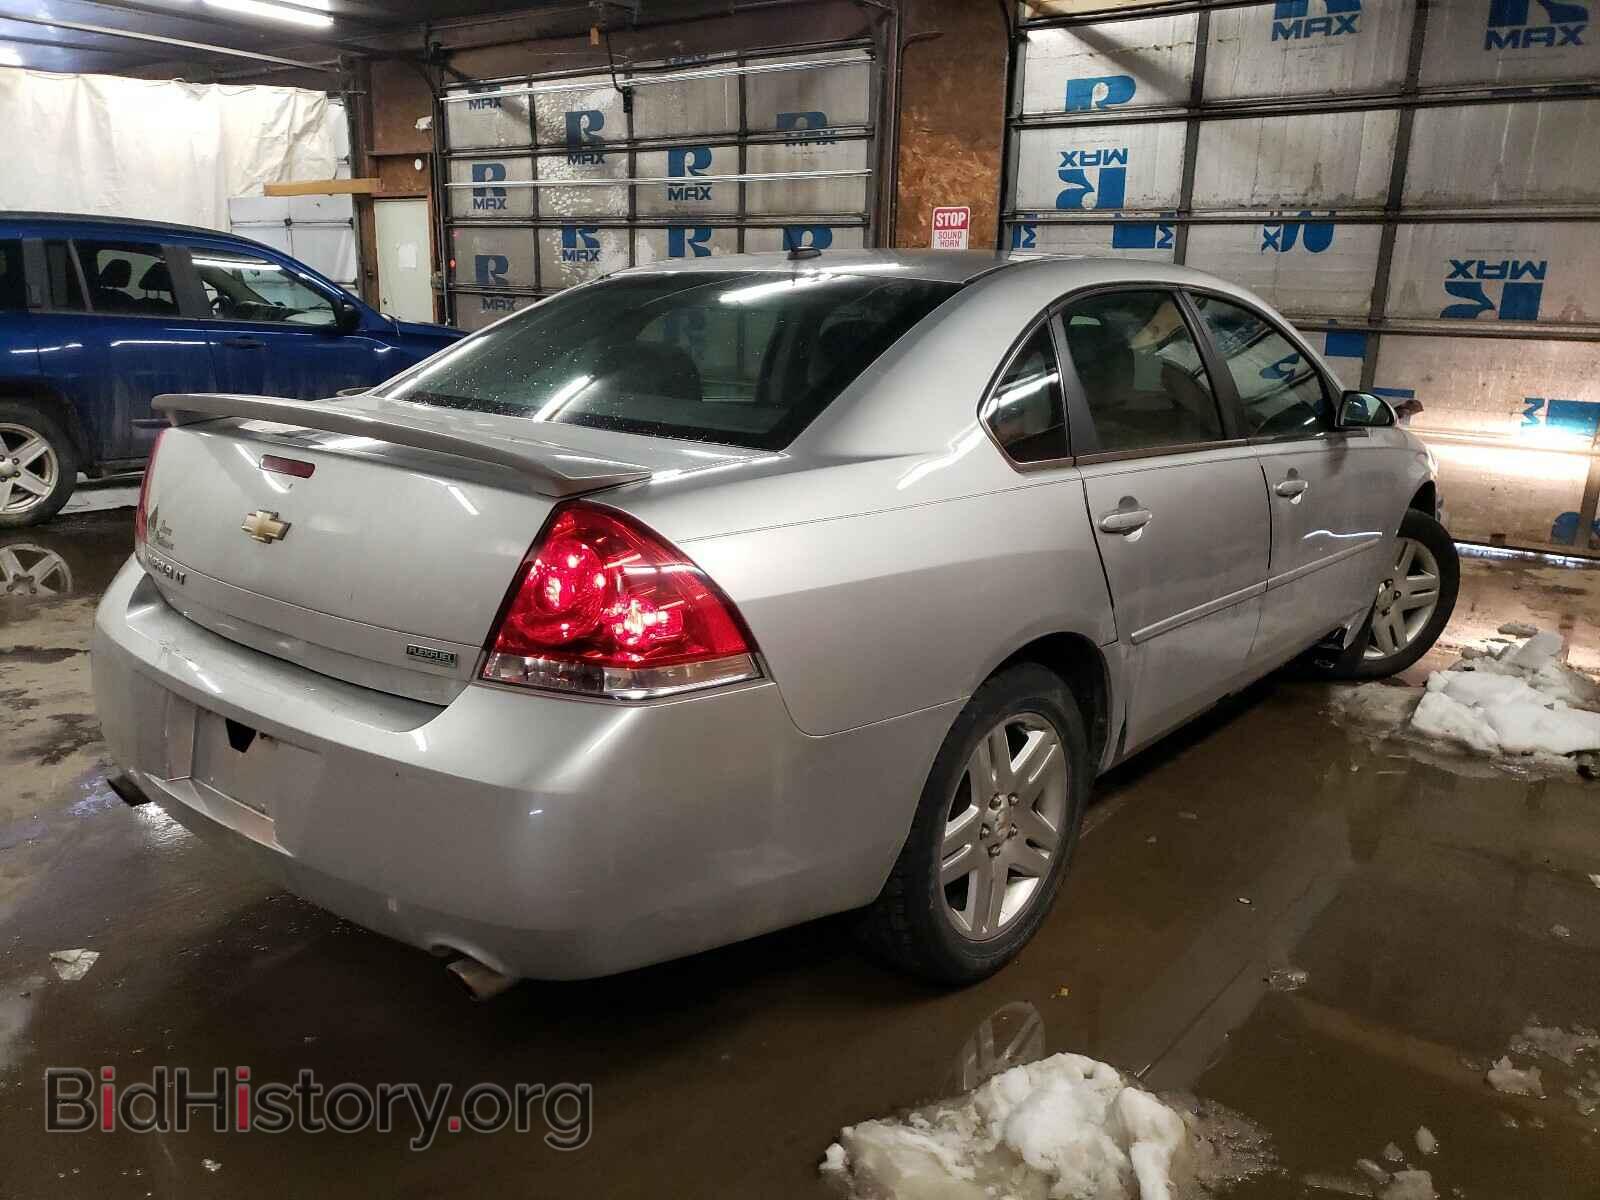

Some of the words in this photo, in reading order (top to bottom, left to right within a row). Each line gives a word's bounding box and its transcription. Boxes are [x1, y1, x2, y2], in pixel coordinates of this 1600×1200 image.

[1271, 14, 1360, 42] MAX
[1485, 25, 1585, 50] MAX
[567, 152, 606, 165] MAX
[1059, 147, 1129, 168] MAX
[668, 146, 712, 186] R
[472, 164, 507, 197] R
[668, 187, 712, 201] MAX
[472, 198, 507, 210] MAX
[936, 212, 967, 227] STOP
[938, 231, 962, 240] SOUND
[940, 240, 960, 248] HORN
[562, 249, 600, 262] MAX
[475, 255, 509, 287] R
[1445, 259, 1548, 281] MAX
[482, 296, 516, 311] MAX
